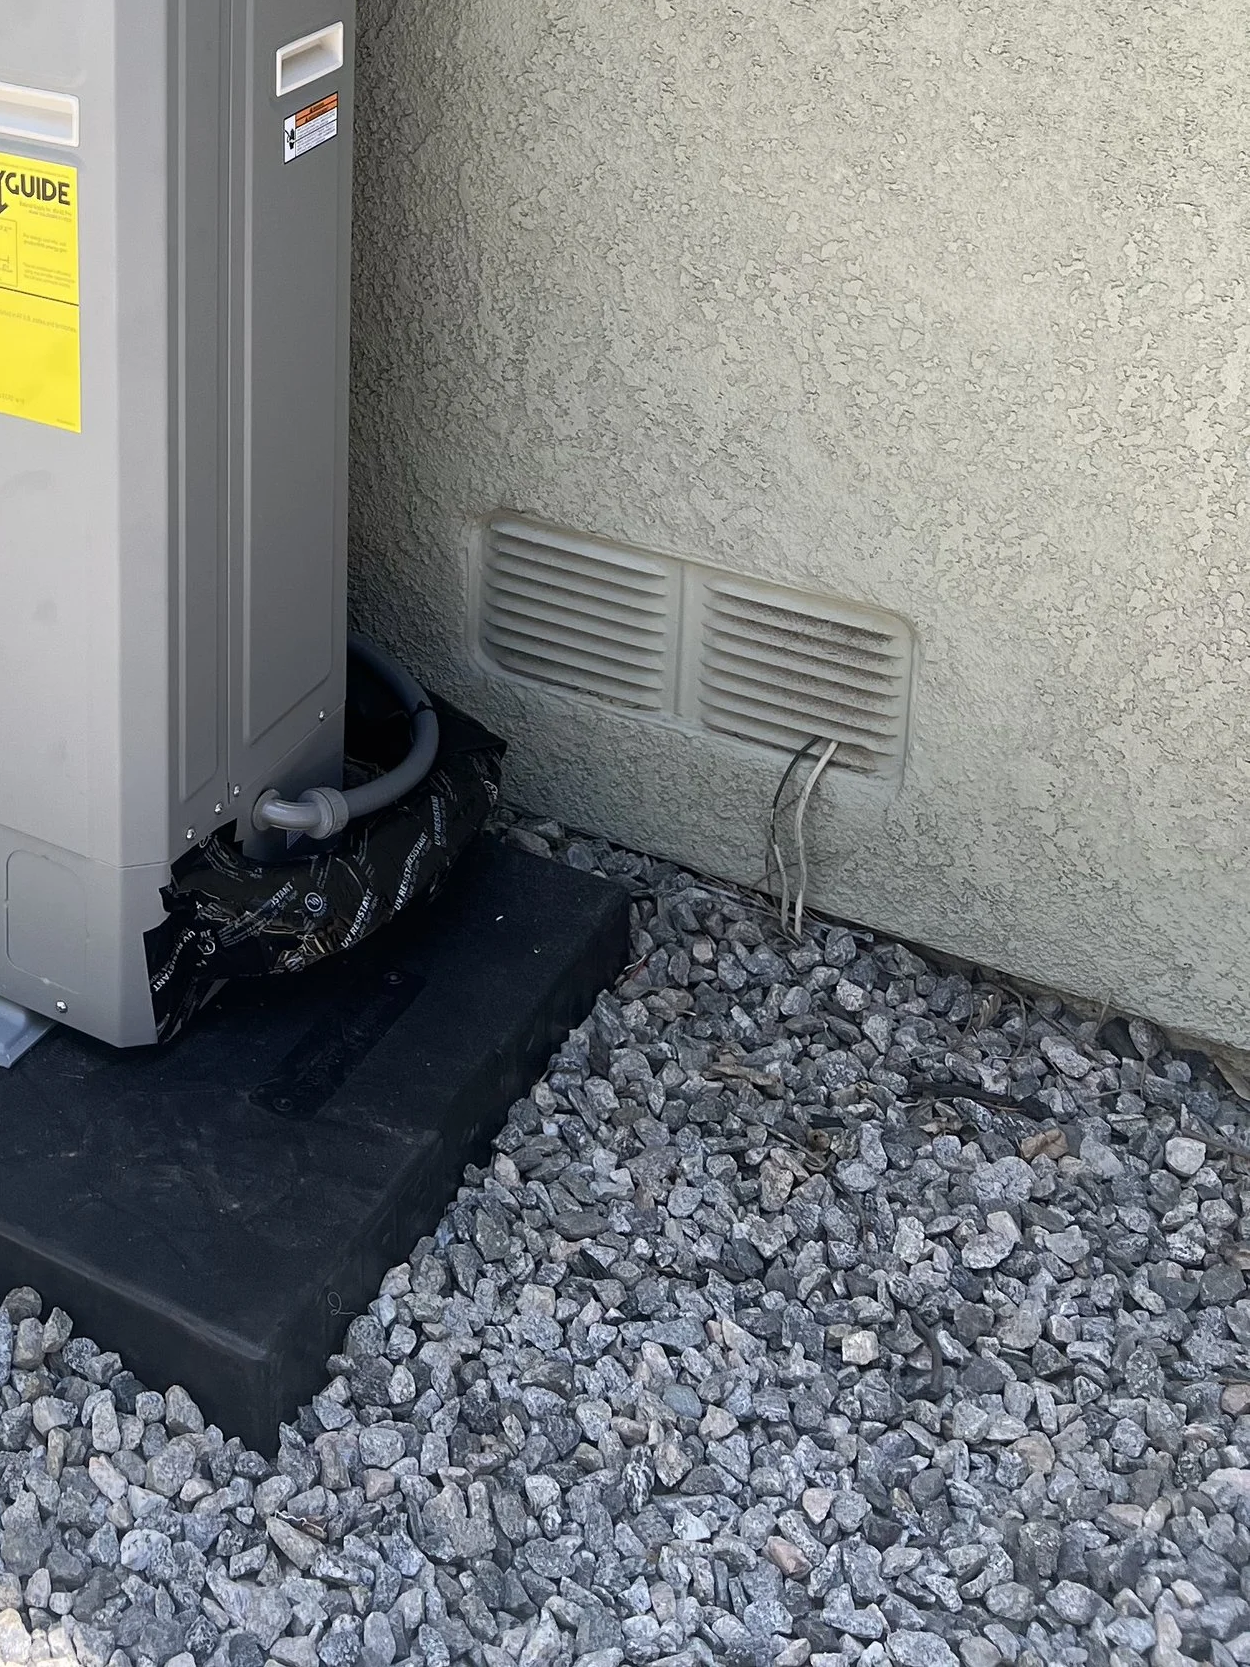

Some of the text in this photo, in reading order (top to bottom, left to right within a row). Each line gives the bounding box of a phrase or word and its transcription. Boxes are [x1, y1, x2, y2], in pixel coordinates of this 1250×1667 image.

[271, 881, 295, 908] ISTANT
[393, 895, 404, 911] UV
[340, 887, 374, 949] UV RESISTANT
[183, 930, 196, 943] UV
